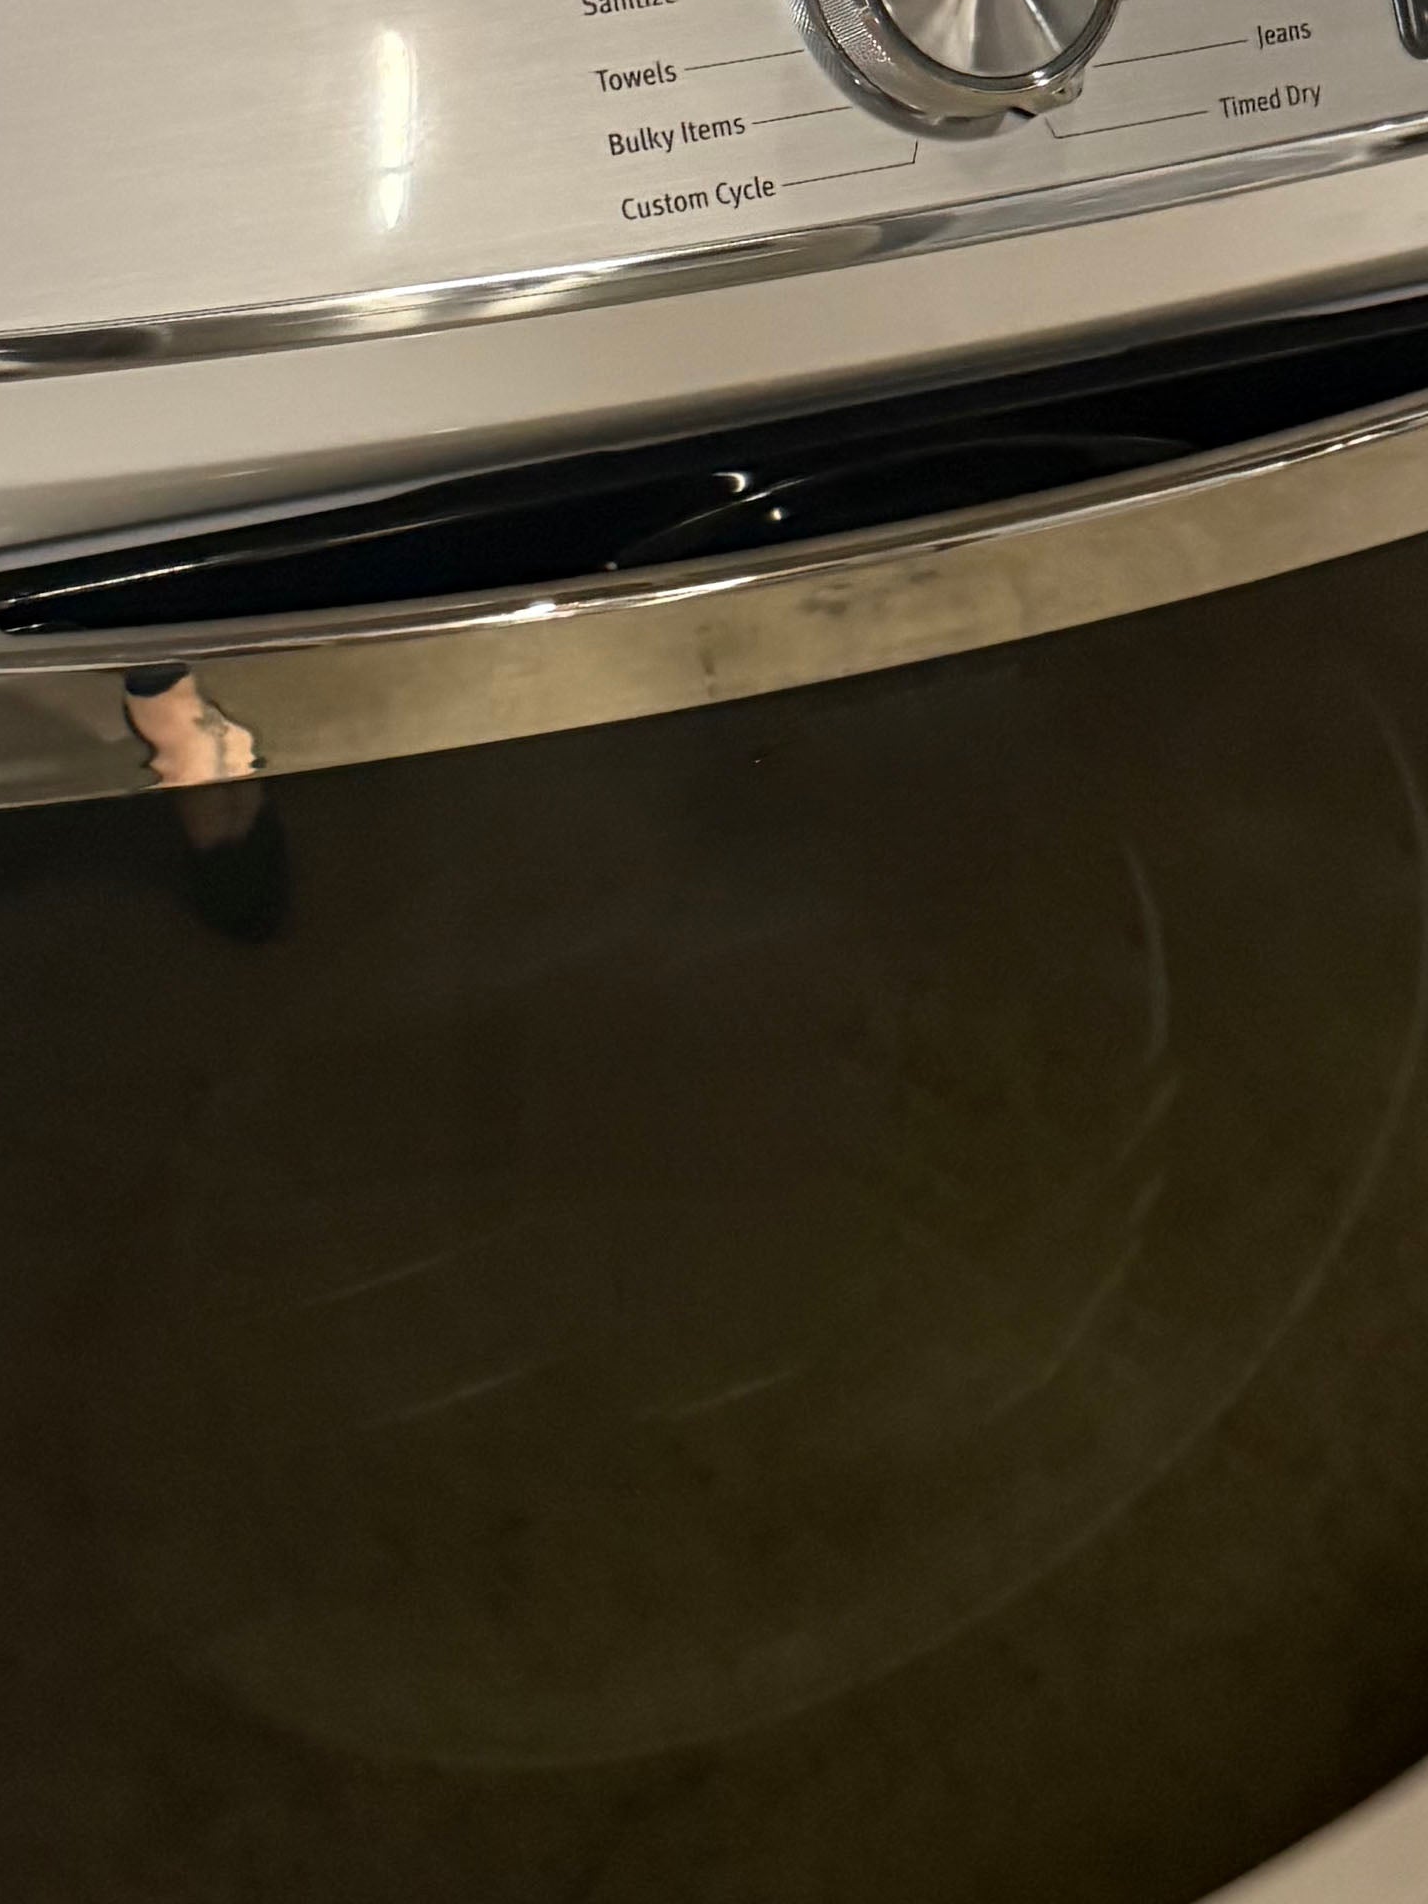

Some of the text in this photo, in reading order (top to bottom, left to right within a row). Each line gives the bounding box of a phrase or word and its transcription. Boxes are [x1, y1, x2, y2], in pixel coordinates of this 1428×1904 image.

[1257, 22, 1312, 49] Jeans
[596, 61, 678, 92] Towels
[1219, 84, 1321, 118] Timed Dry
[608, 117, 746, 156] Bulky Items
[621, 176, 776, 220] Custom Cycle
